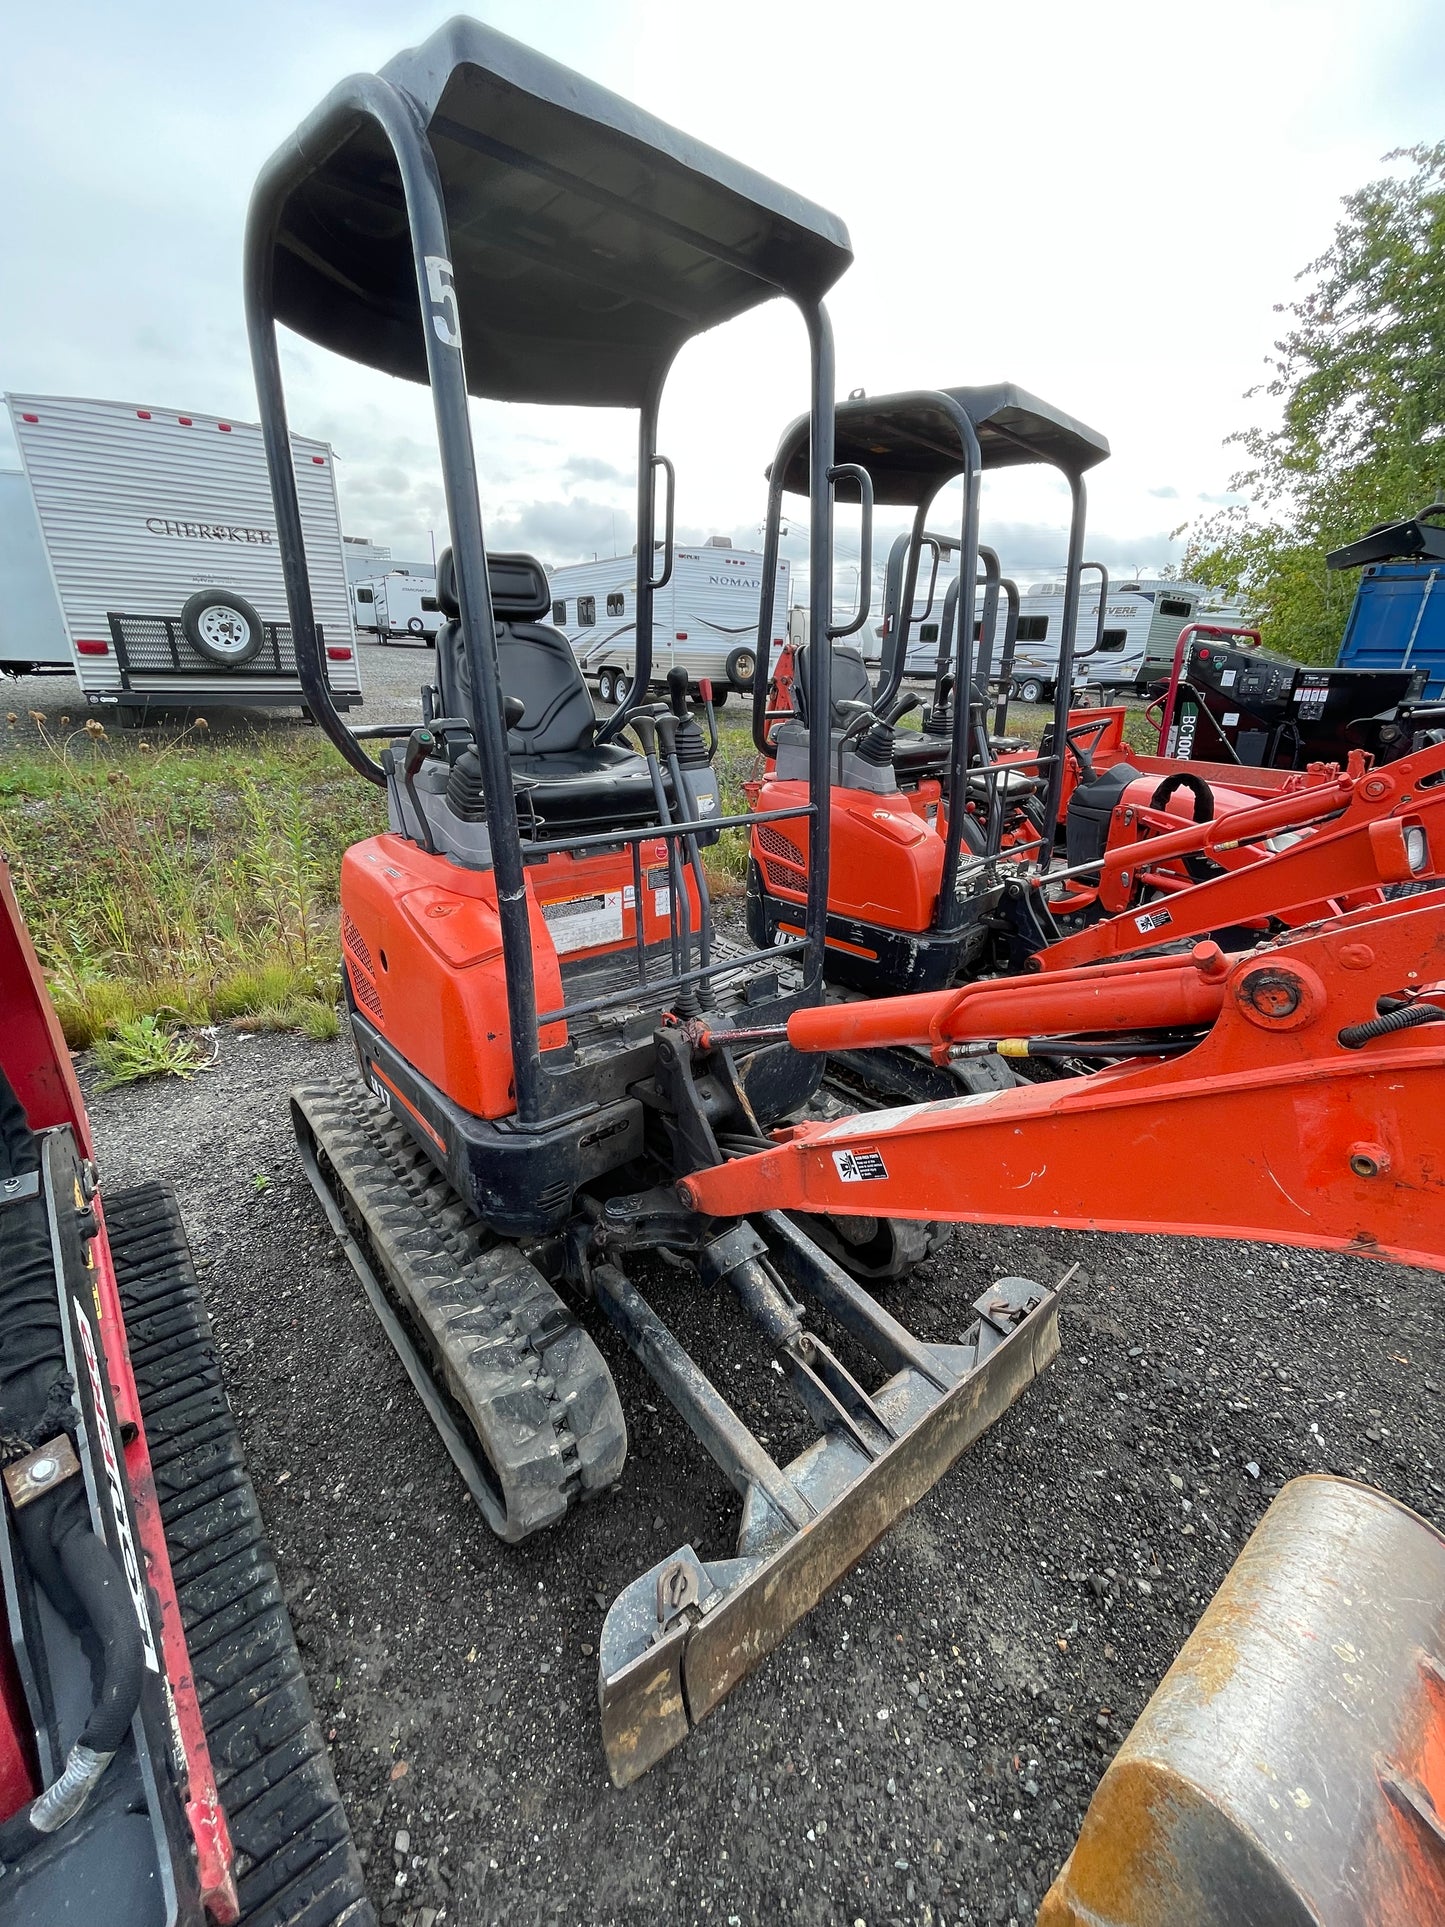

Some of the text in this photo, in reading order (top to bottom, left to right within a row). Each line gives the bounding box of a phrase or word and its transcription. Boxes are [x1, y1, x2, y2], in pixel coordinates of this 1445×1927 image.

[423, 255, 462, 349] 5
[145, 517, 273, 546] CHEROKEE
[708, 575, 761, 588] NOMAD
